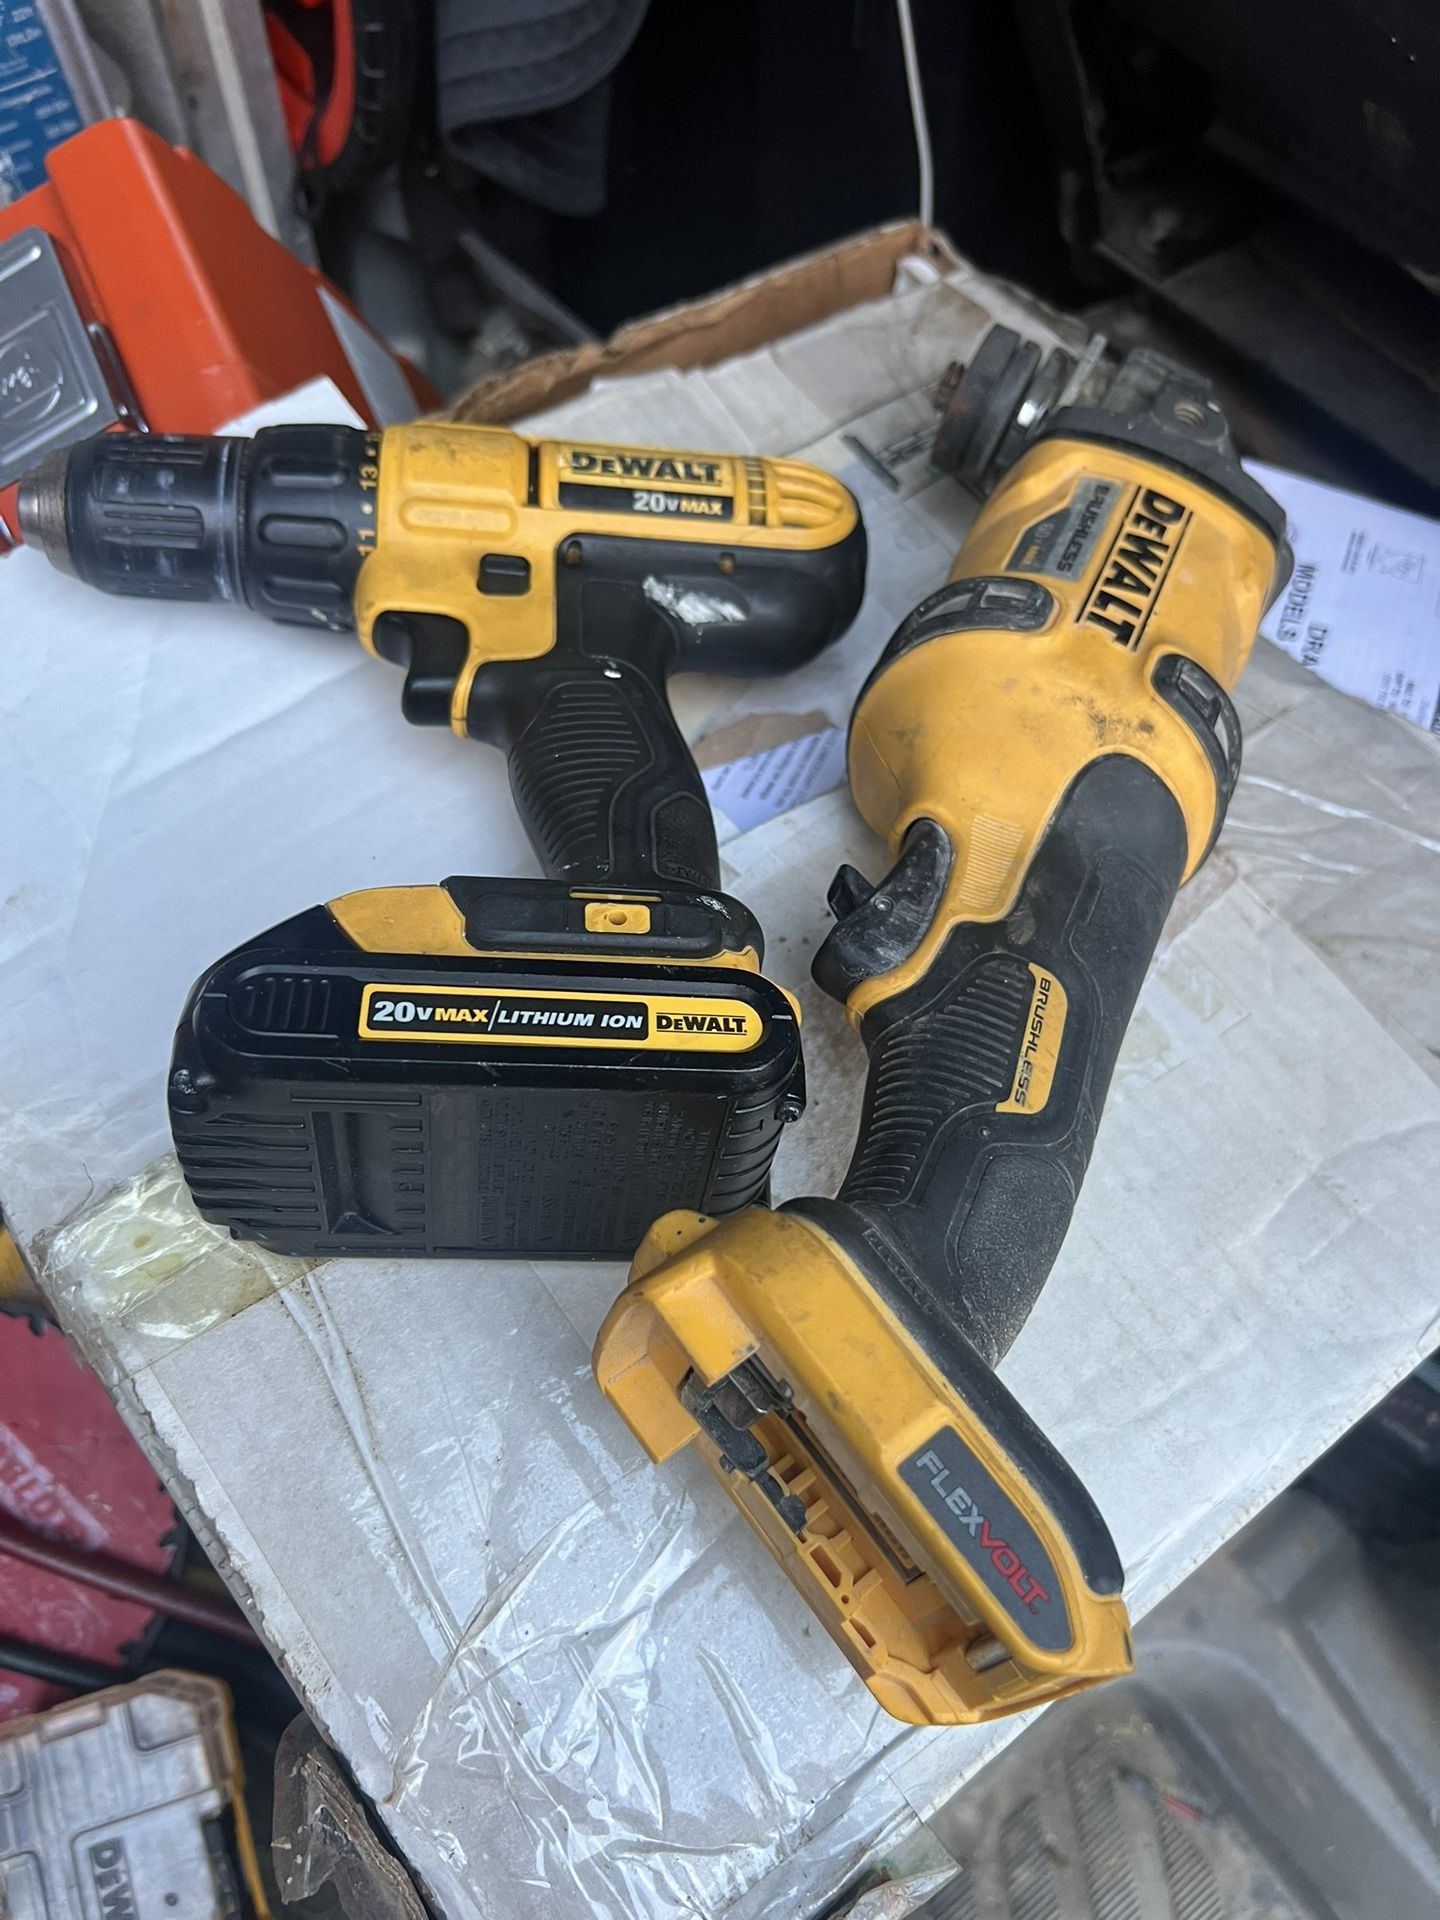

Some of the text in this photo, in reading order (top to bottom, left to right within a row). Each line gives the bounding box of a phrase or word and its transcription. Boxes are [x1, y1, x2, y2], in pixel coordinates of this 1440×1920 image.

[360, 464, 378, 490] 13
[358, 528, 376, 556] 11
[1057, 484, 1110, 573] BRUSHLESS
[1086, 488, 1186, 648] DEWALT
[1276, 564, 1317, 642] MODELS
[600, 1013, 643, 1030] ION
[1014, 977, 1051, 1108] BRUSHLESS
[915, 1449, 1049, 1605] FLEXVOLT
